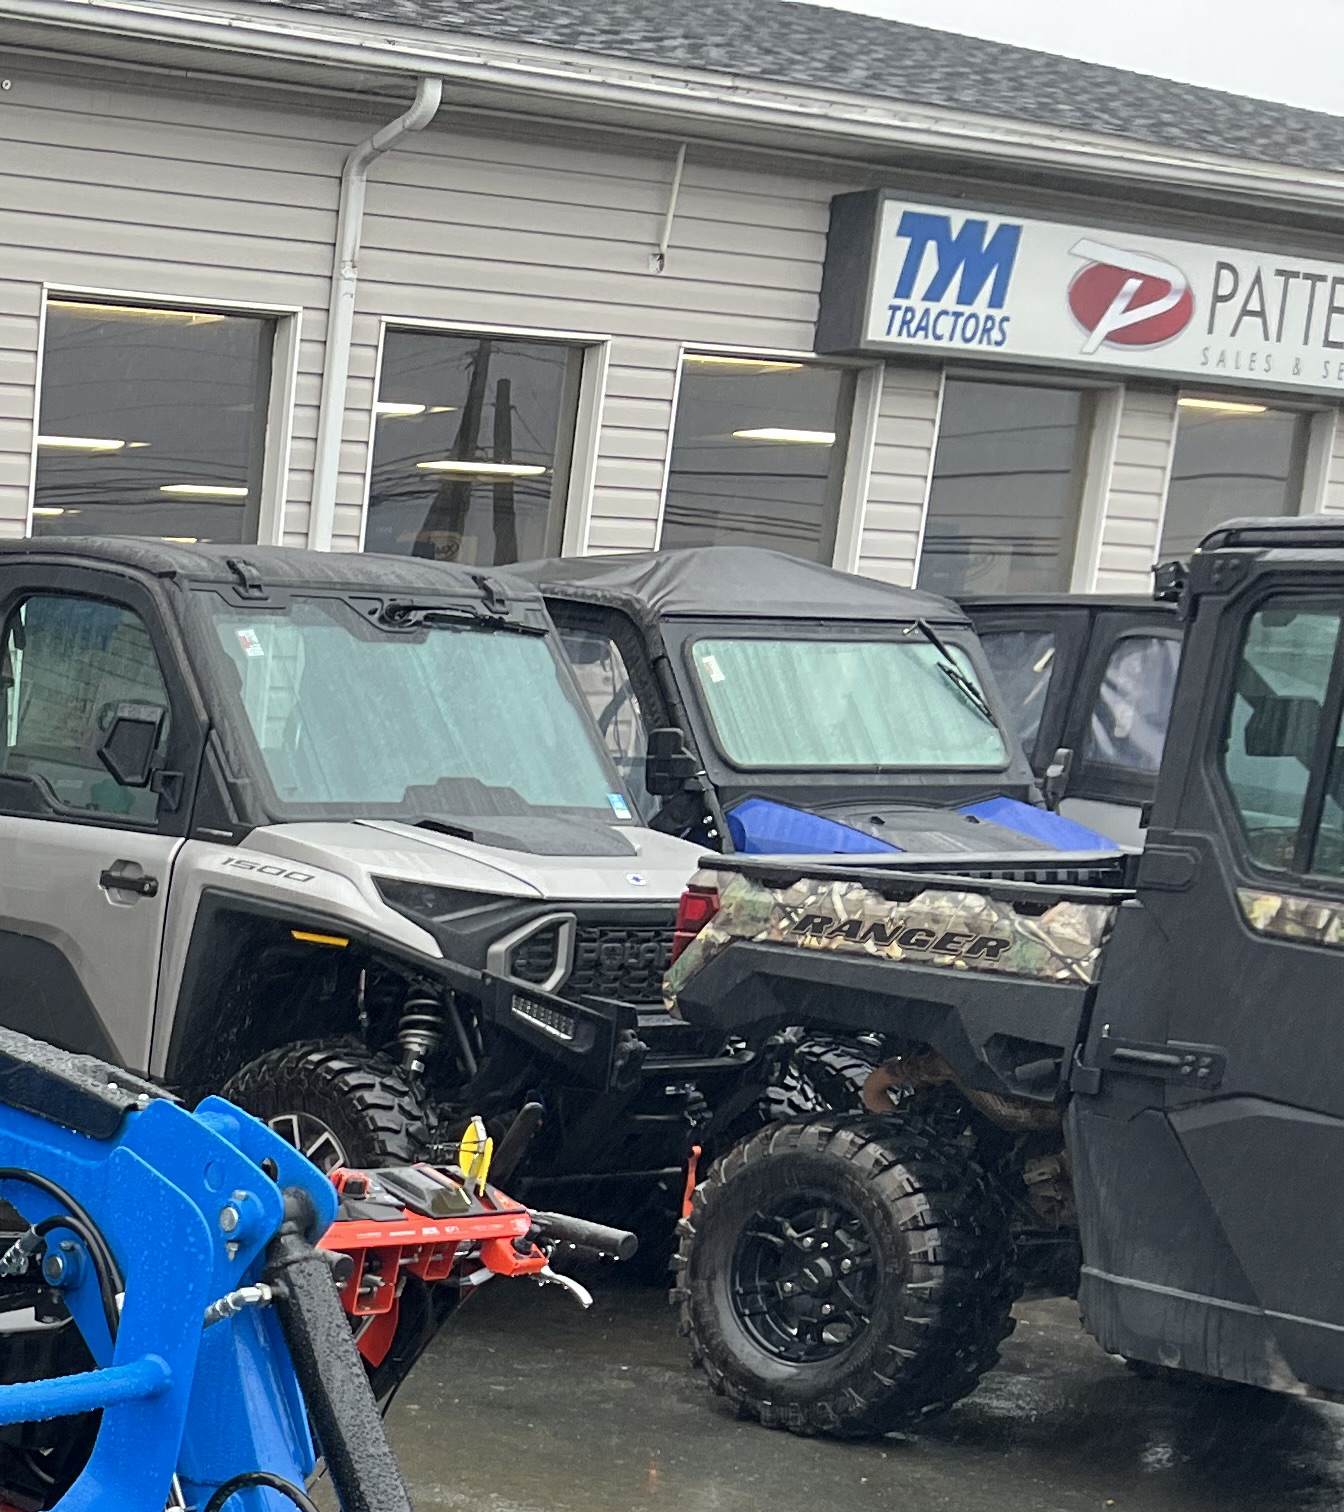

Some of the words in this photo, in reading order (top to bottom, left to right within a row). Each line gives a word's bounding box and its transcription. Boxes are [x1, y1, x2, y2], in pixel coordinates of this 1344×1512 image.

[893, 211, 1023, 309] TYM
[885, 304, 1011, 347] TRACTORS
[1207, 260, 1344, 348] PATTE
[1201, 346, 1273, 374] SALES
[1291, 357, 1302, 377] &
[222, 857, 315, 882] 1500
[791, 913, 1013, 963] RANGER
